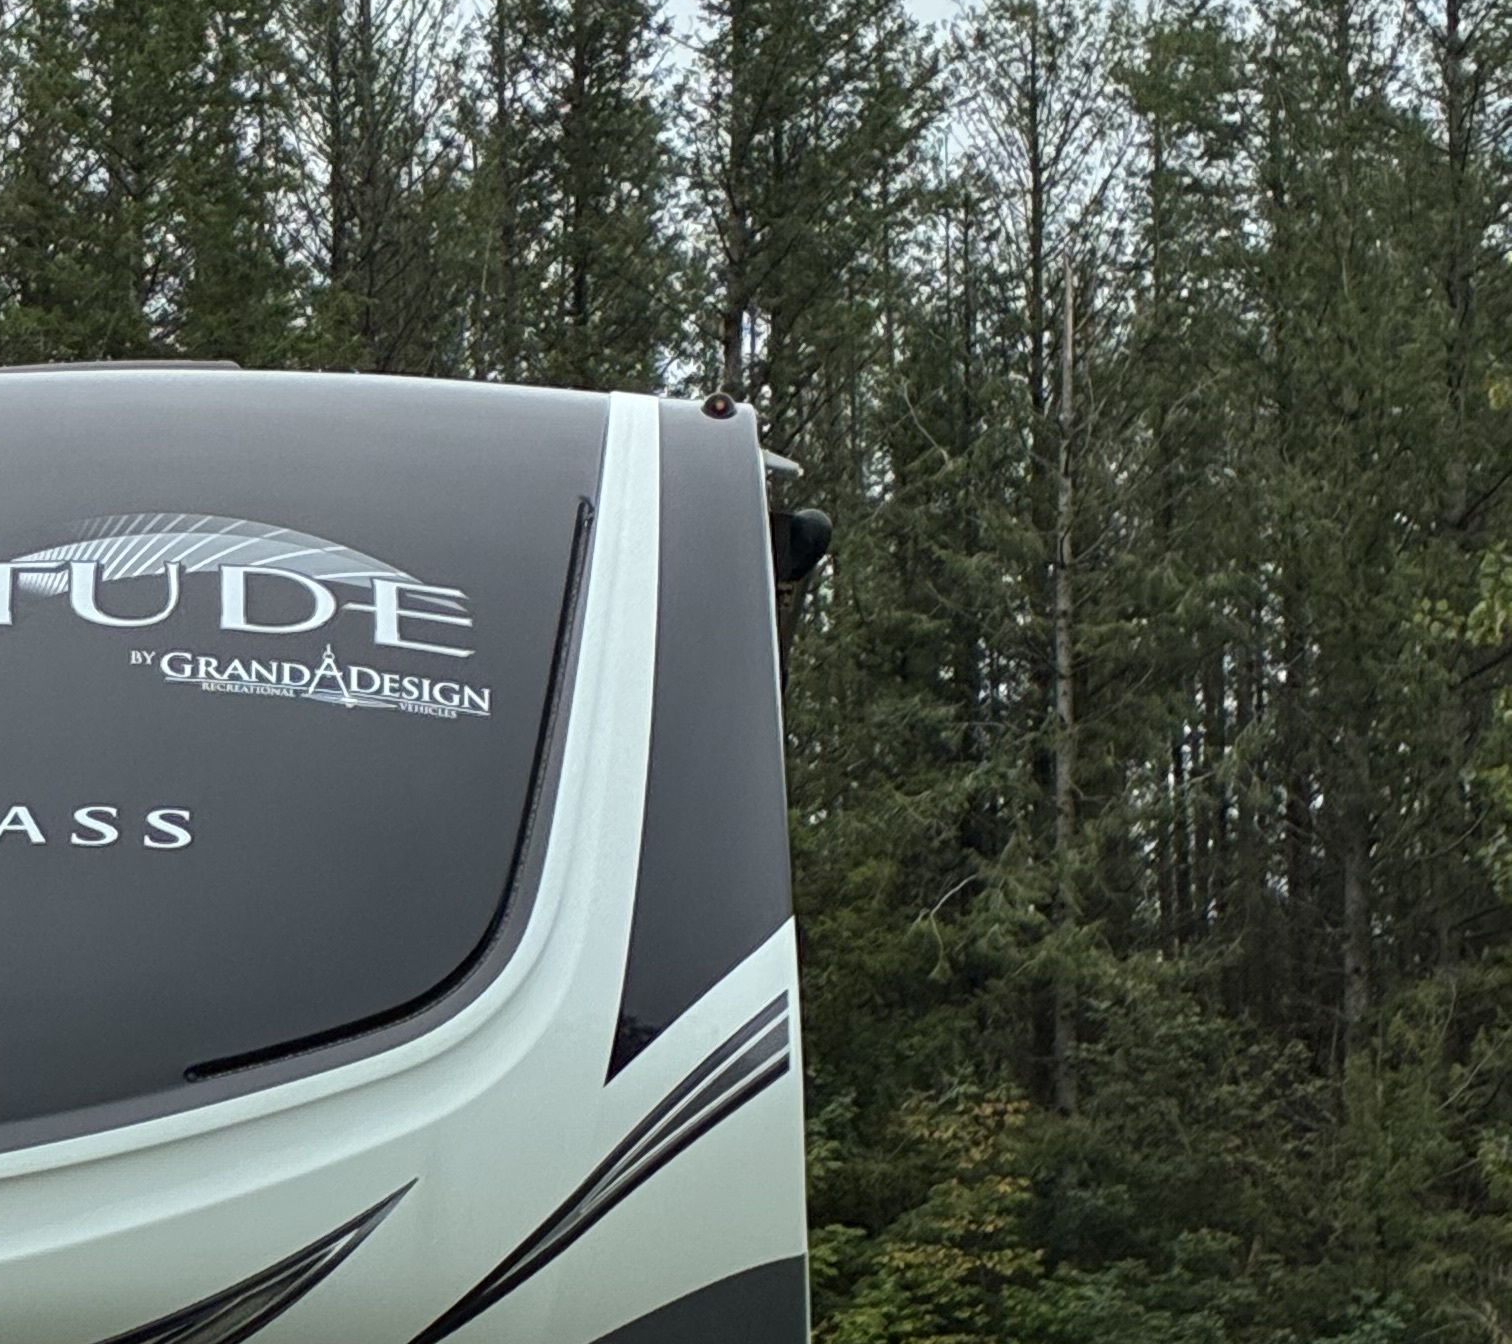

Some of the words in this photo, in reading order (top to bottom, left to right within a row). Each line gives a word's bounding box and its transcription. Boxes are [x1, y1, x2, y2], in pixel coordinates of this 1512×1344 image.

[129, 650, 156, 665] BY
[160, 652, 310, 686] GRAND
[350, 666, 490, 711] DESIGN
[202, 682, 295, 697] RECREATIONAL
[399, 702, 458, 718] VEHICLES
